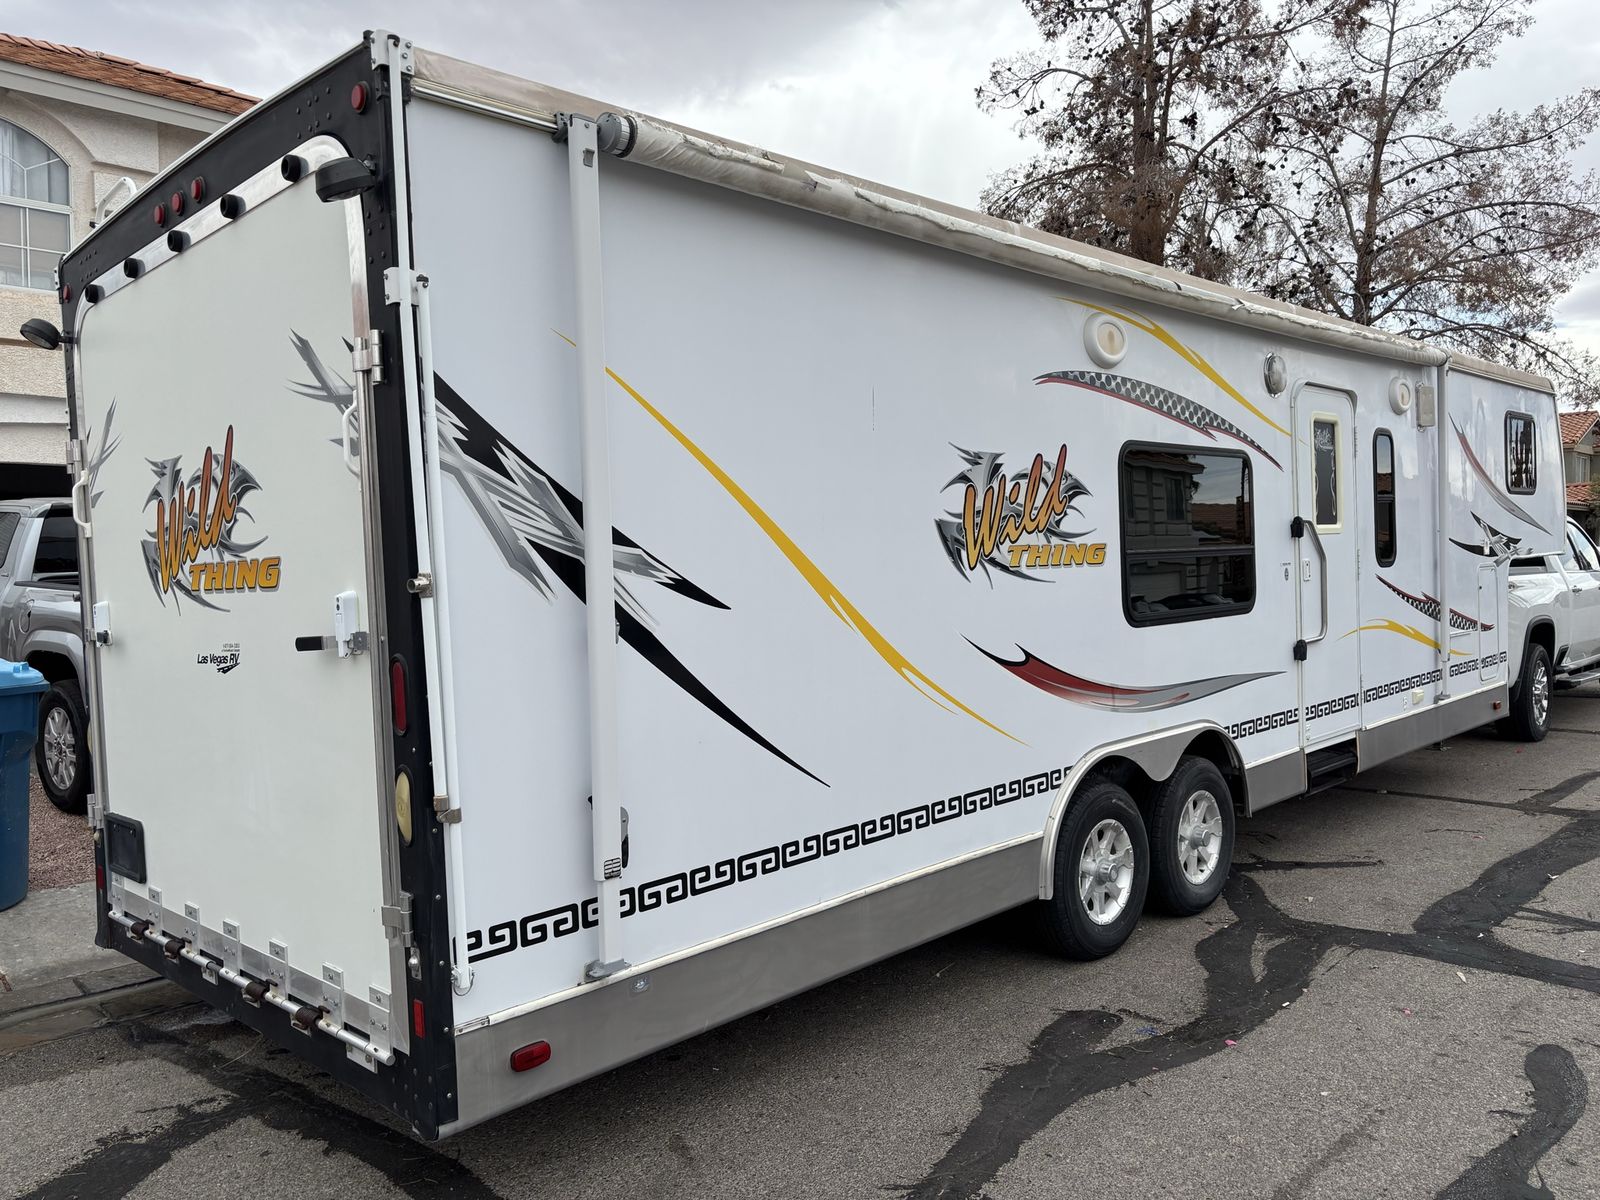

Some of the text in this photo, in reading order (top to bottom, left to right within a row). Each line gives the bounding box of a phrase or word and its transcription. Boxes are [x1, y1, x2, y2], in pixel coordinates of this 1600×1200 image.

[157, 424, 238, 594] Wild
[962, 443, 1069, 571] Wild
[189, 556, 281, 593] THING
[1008, 543, 1107, 569] THING
[197, 653, 240, 667] Las Vegas RV
